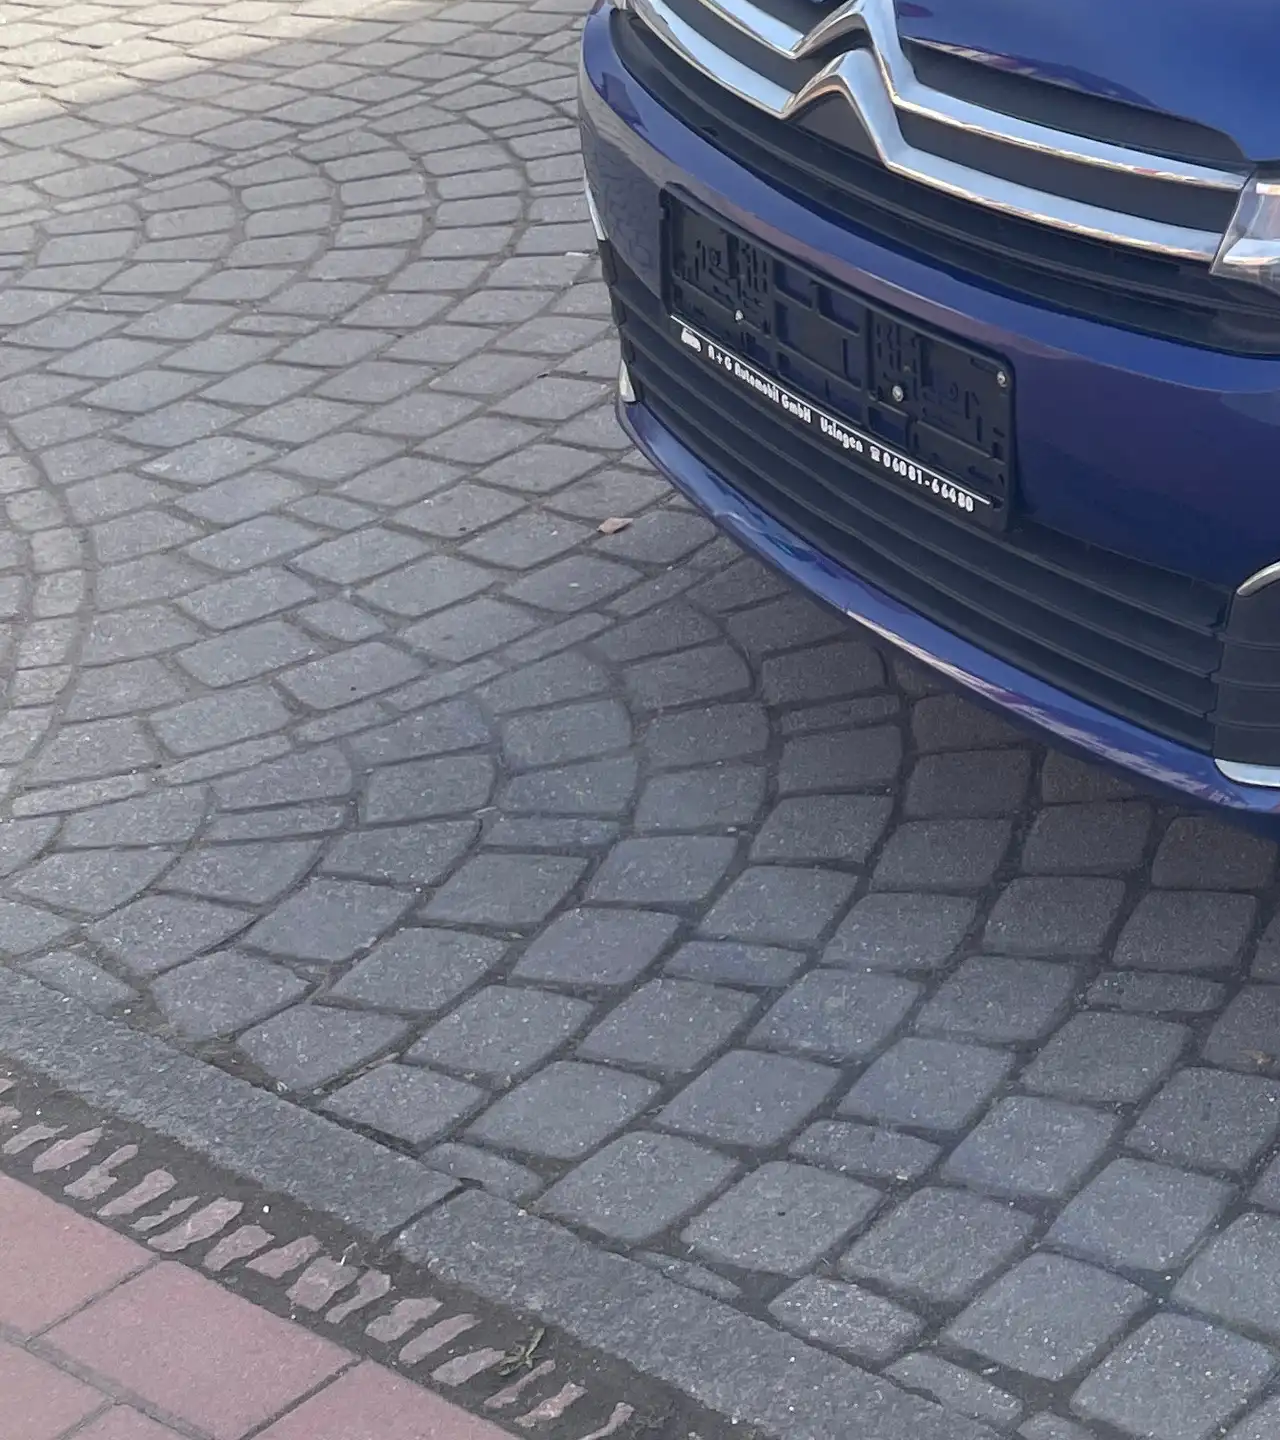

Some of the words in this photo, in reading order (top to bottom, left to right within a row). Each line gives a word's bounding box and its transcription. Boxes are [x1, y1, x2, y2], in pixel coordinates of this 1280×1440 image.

[708, 344, 715, 361] A
[724, 356, 732, 371] G
[734, 362, 780, 404] Automobil
[781, 393, 812, 424] GmbH
[820, 416, 864, 453] Usingen
